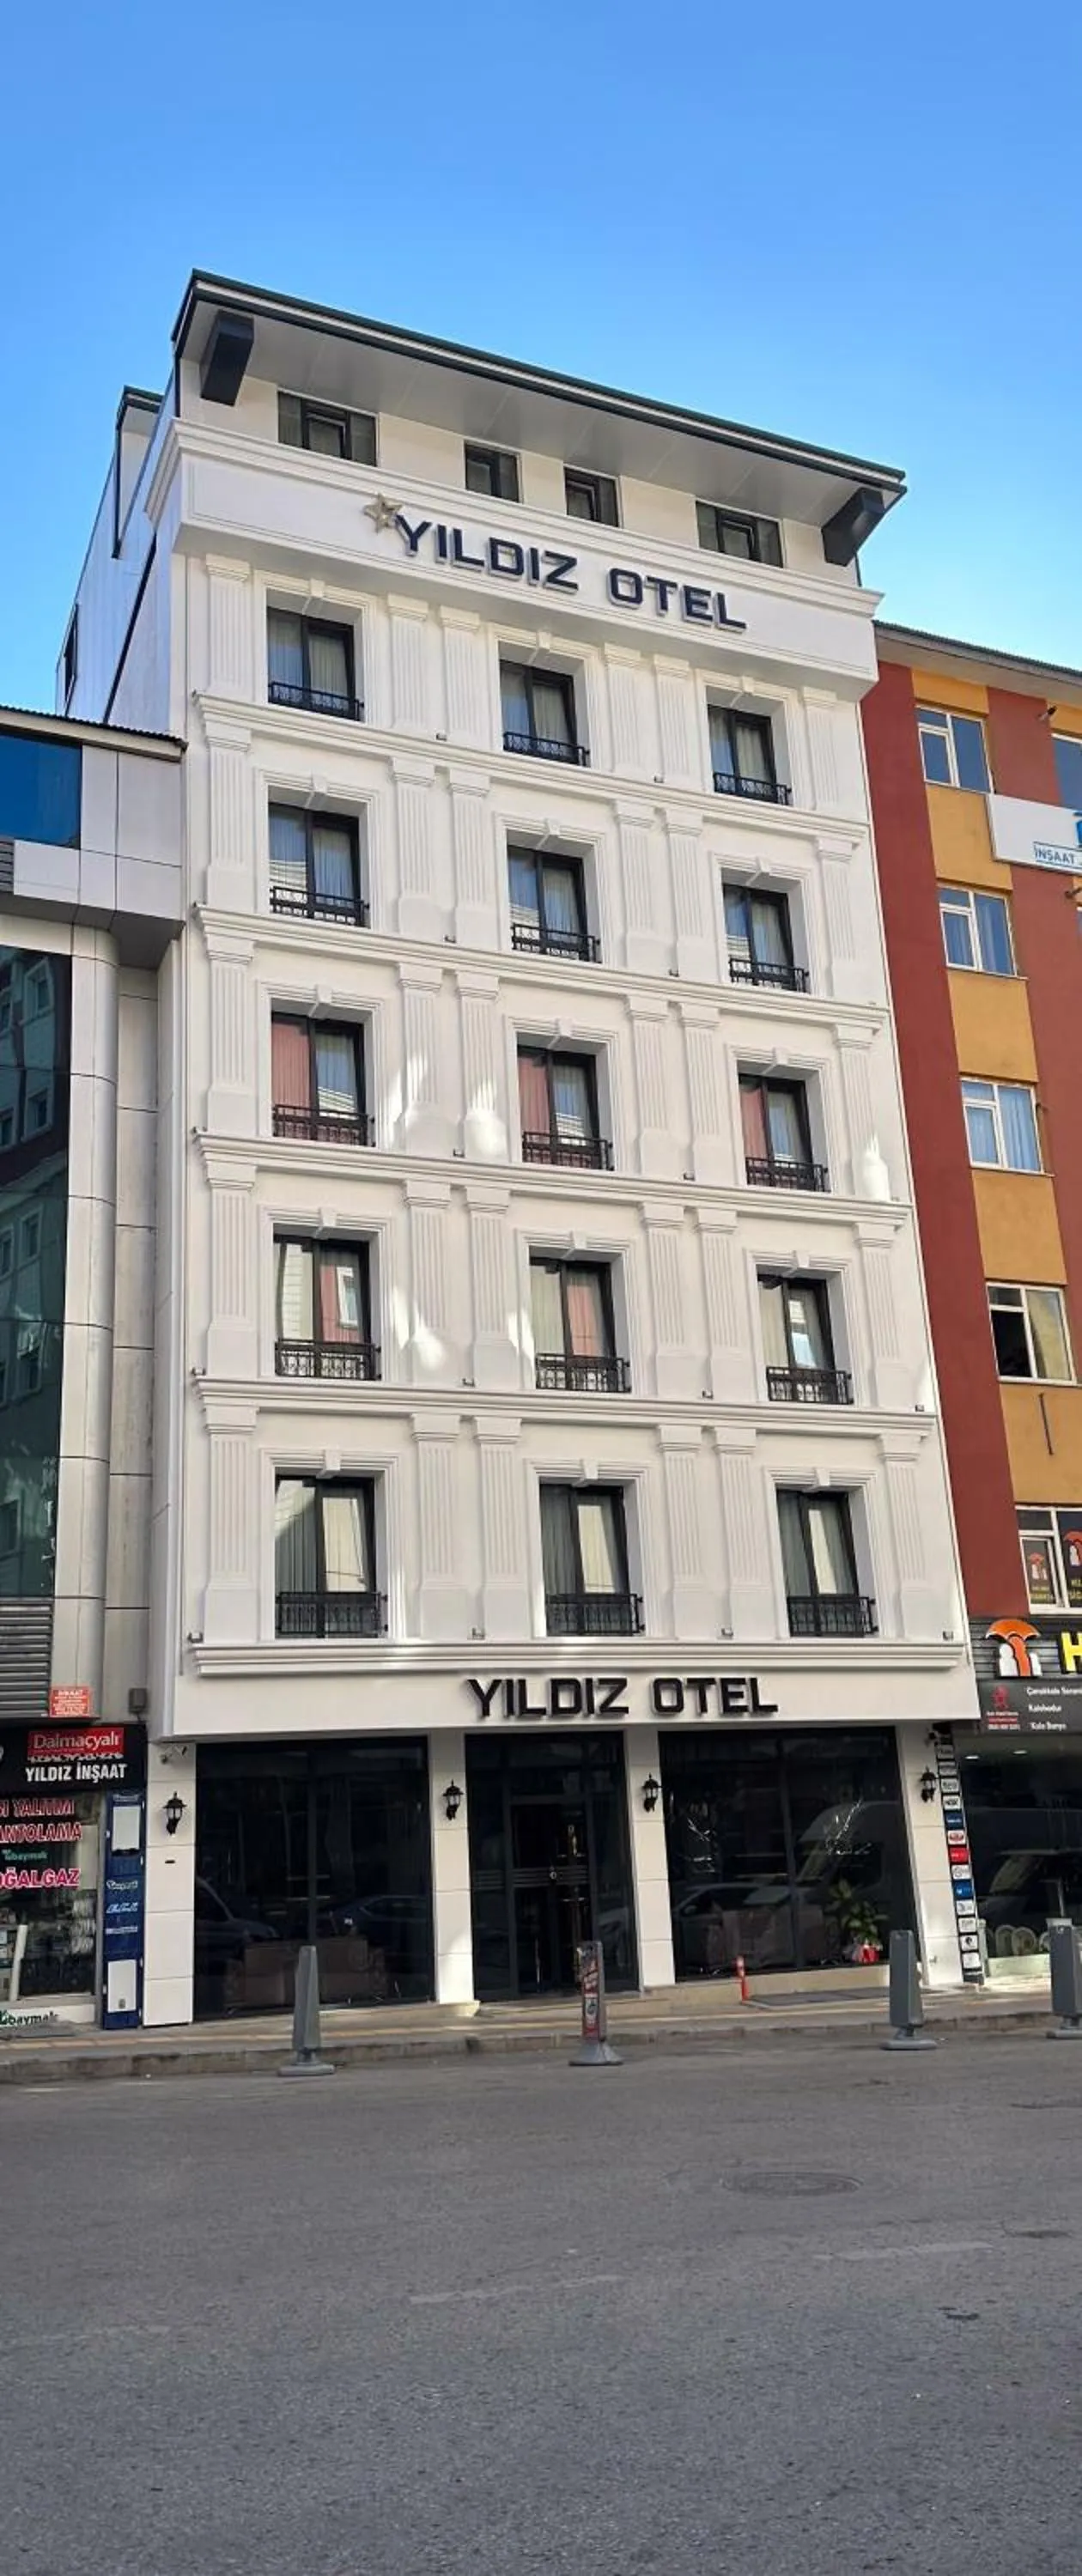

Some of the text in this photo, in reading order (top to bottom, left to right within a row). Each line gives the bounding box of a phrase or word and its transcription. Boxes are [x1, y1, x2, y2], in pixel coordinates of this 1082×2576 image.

[394, 513, 747, 634] YILDIZ OTEL
[467, 1676, 780, 1717] YILDIZ OTEL
[26, 1762, 128, 1783] YILDIZ İNŞAAT
